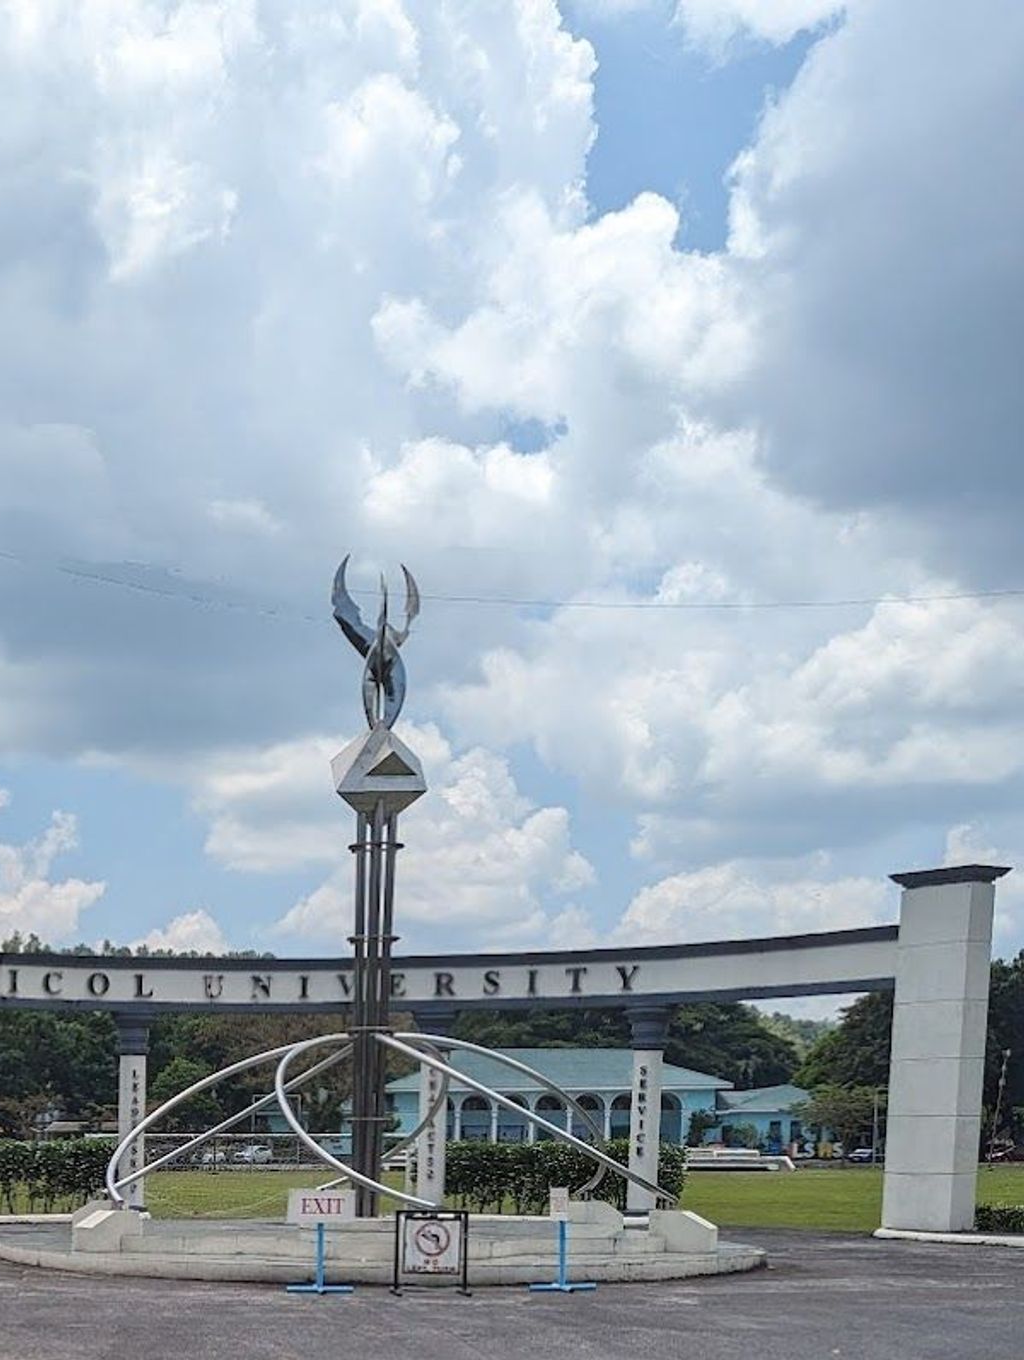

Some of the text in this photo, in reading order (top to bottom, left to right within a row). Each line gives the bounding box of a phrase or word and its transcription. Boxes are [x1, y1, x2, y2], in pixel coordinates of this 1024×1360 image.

[203, 964, 640, 999] UNIVERSITY
[636, 1065, 648, 1157] SERVICE
[301, 1197, 346, 1215] EXIT
